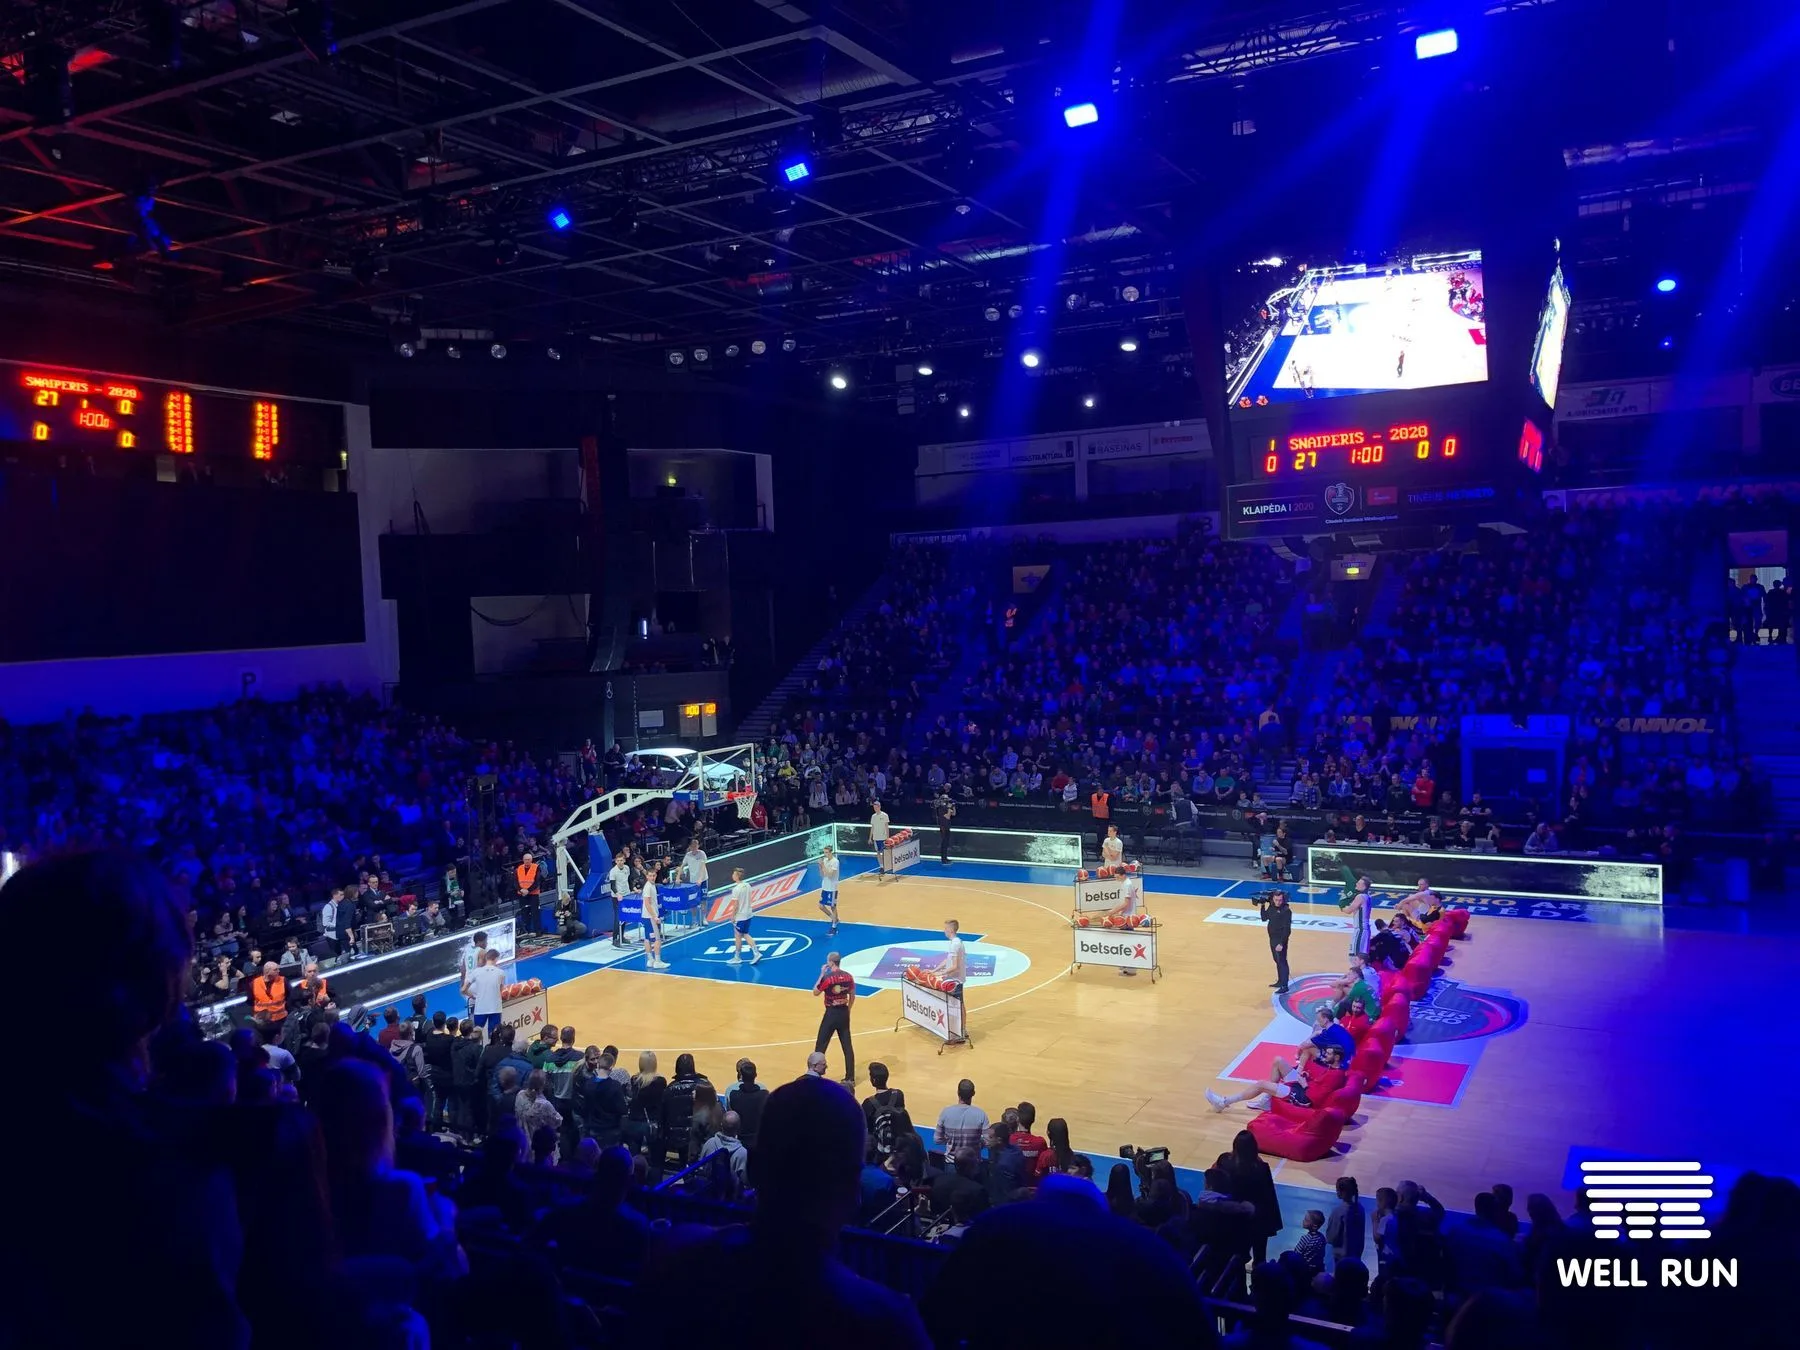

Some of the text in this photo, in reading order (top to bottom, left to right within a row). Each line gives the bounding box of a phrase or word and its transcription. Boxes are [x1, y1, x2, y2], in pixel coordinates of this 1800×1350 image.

[25, 376, 89, 393] SNAIPERIS
[37, 390, 59, 407] 27
[119, 399, 131, 415] 0
[35, 423, 49, 441] 0
[120, 432, 133, 448] 0
[1289, 432, 1365, 451] SNAIPERIS
[1390, 425, 1429, 441] 2020
[1267, 439, 1456, 473] 0 27 1:00 0 0
[1243, 501, 1314, 516] KLAIPĖDA 2020
[242, 672, 256, 697] P
[1595, 717, 1714, 734] ANNOL
[1086, 889, 1121, 903] betsaf
[1081, 940, 1133, 957] betsafe
[906, 994, 937, 1022] betsafe
